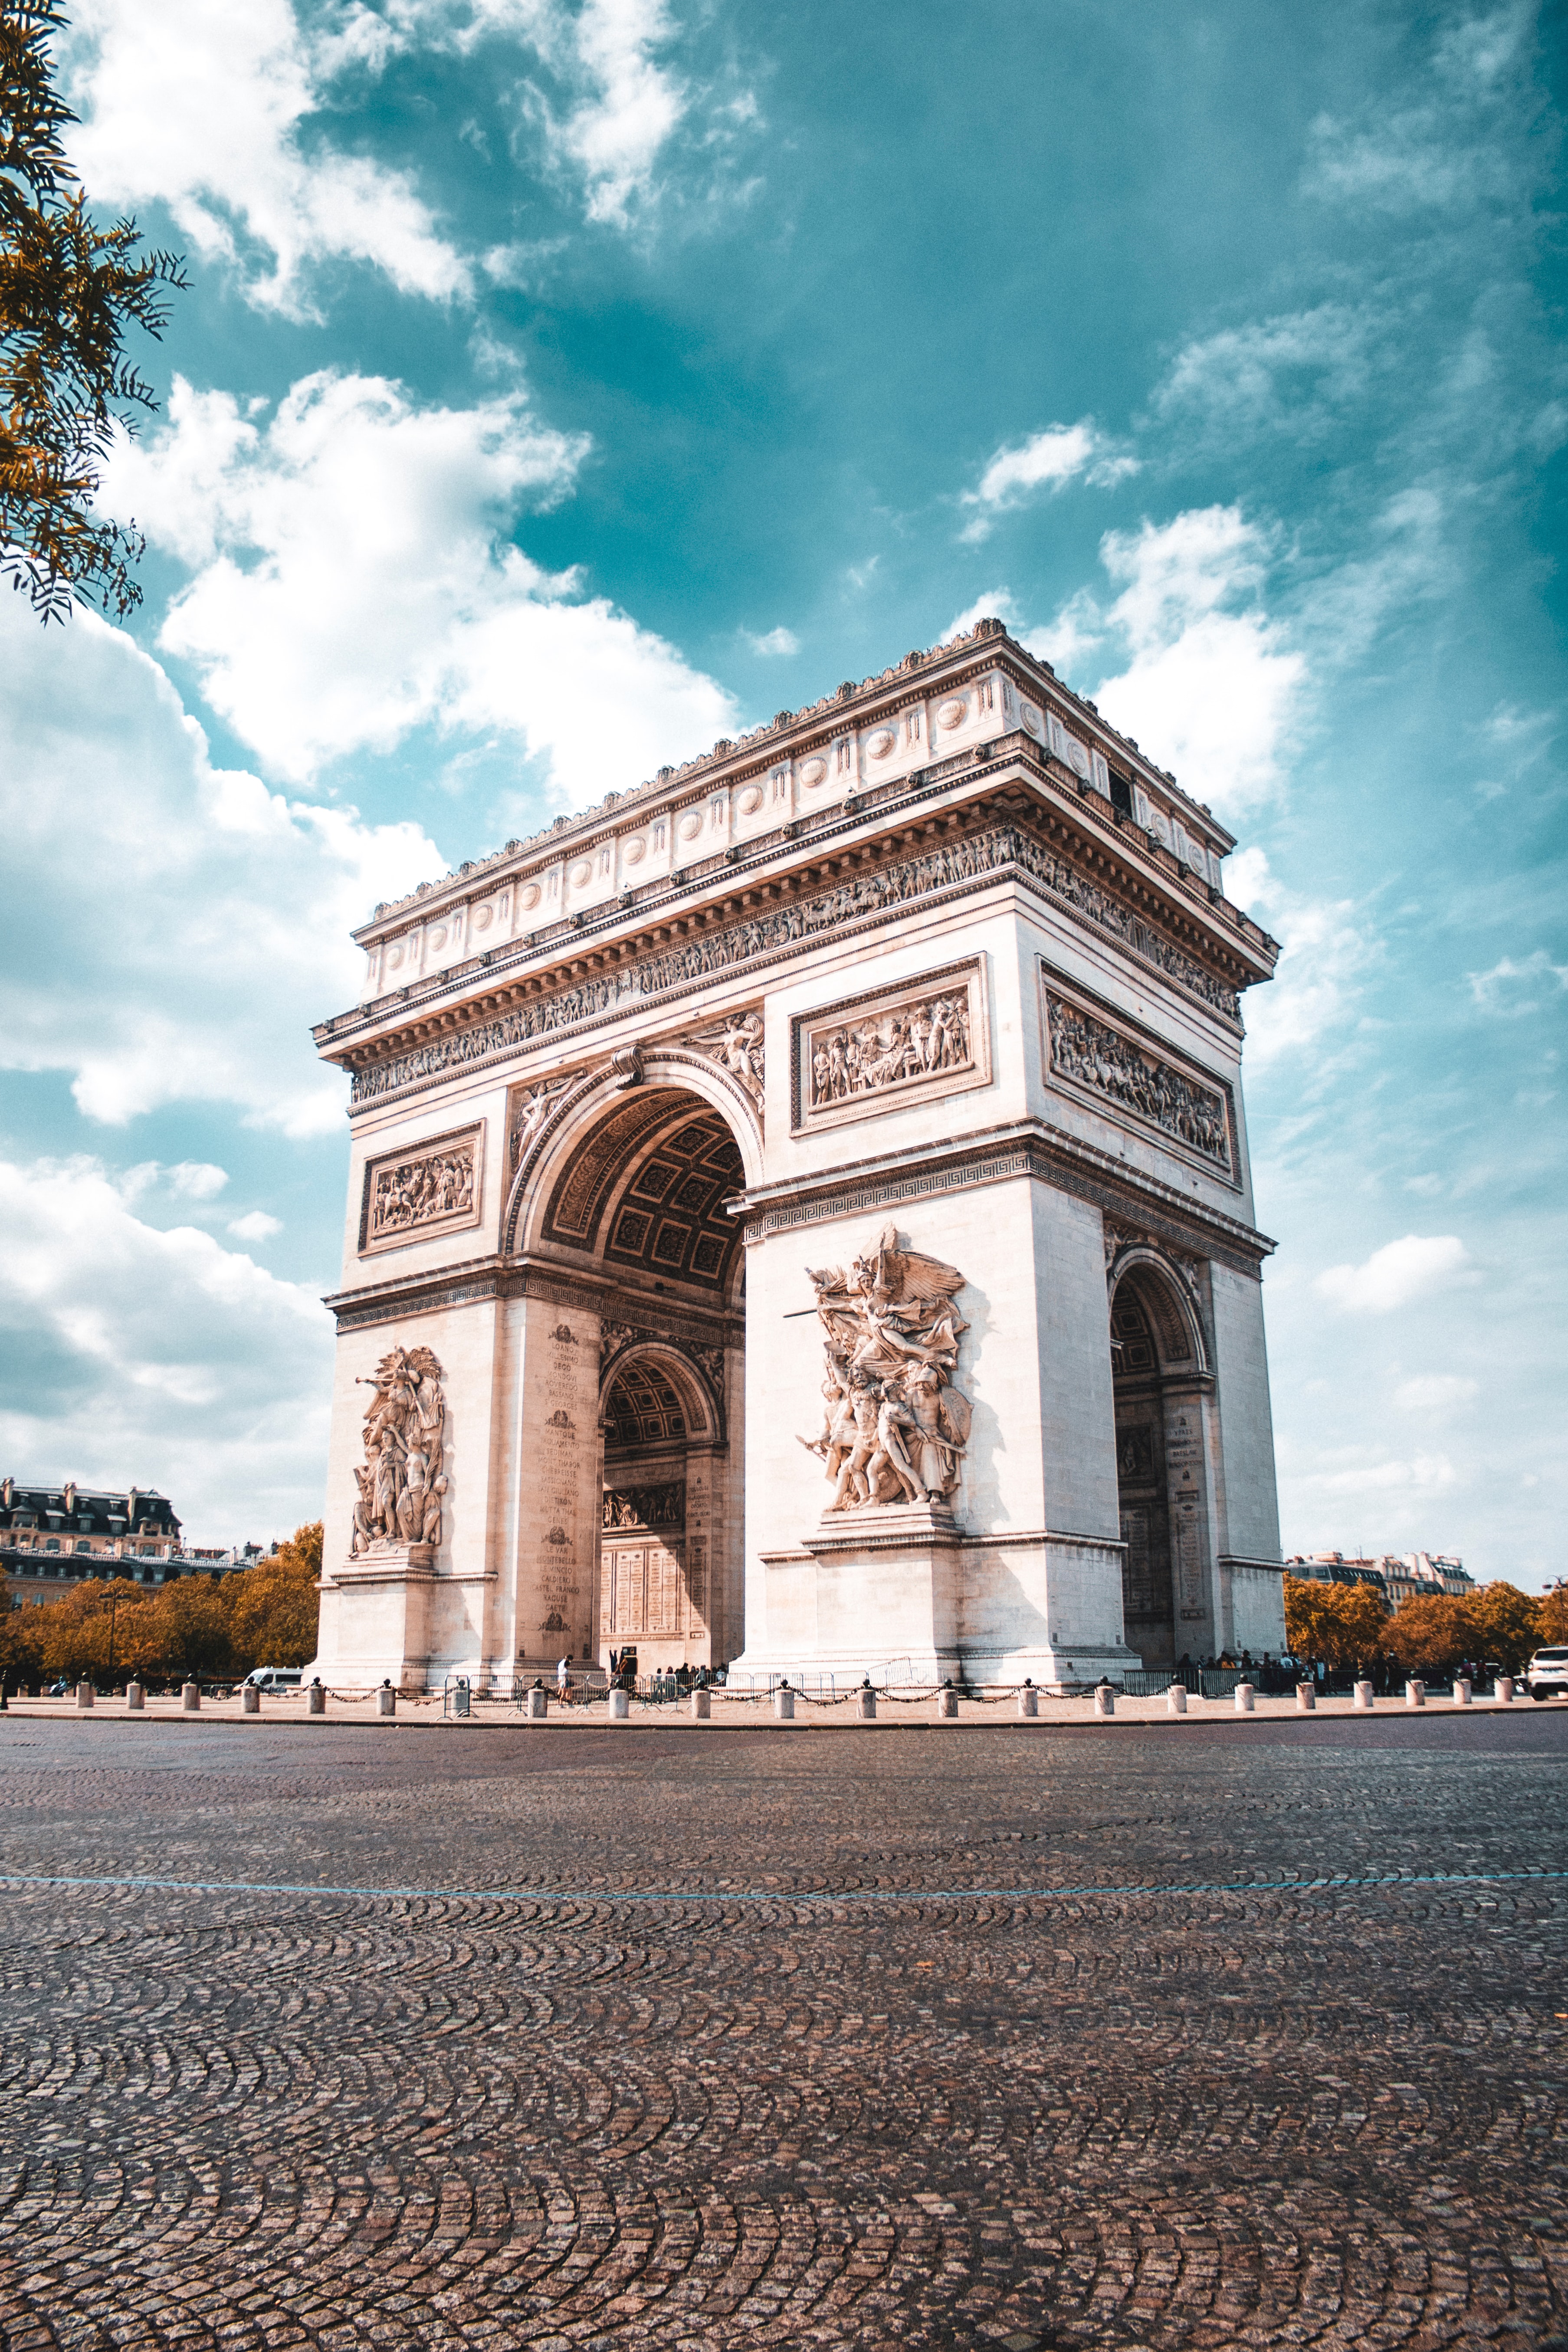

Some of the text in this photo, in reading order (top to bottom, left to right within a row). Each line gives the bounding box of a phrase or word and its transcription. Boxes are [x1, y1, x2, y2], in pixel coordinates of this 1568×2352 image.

[552, 1342, 574, 1353] LOANO
[548, 1351, 578, 1364] MILLESIMO
[548, 1371, 577, 1382] MONDOVI
[545, 1379, 578, 1391] ROVEREDO
[549, 1389, 574, 1400] BASSANO
[551, 1399, 577, 1411] GEORGES
[545, 1428, 576, 1440] MANTOUE
[546, 1448, 573, 1458] SEDIMAN
[558, 1460, 581, 1470] THABOR
[551, 1487, 579, 1497] GIULIANO
[537, 1555, 576, 1565] MONTEBELLO
[548, 1567, 572, 1575] MINCIO
[541, 1575, 571, 1584] CALDIERO
[556, 1586, 580, 1594] FRANCO
[544, 1594, 568, 1603] RAGUSE
